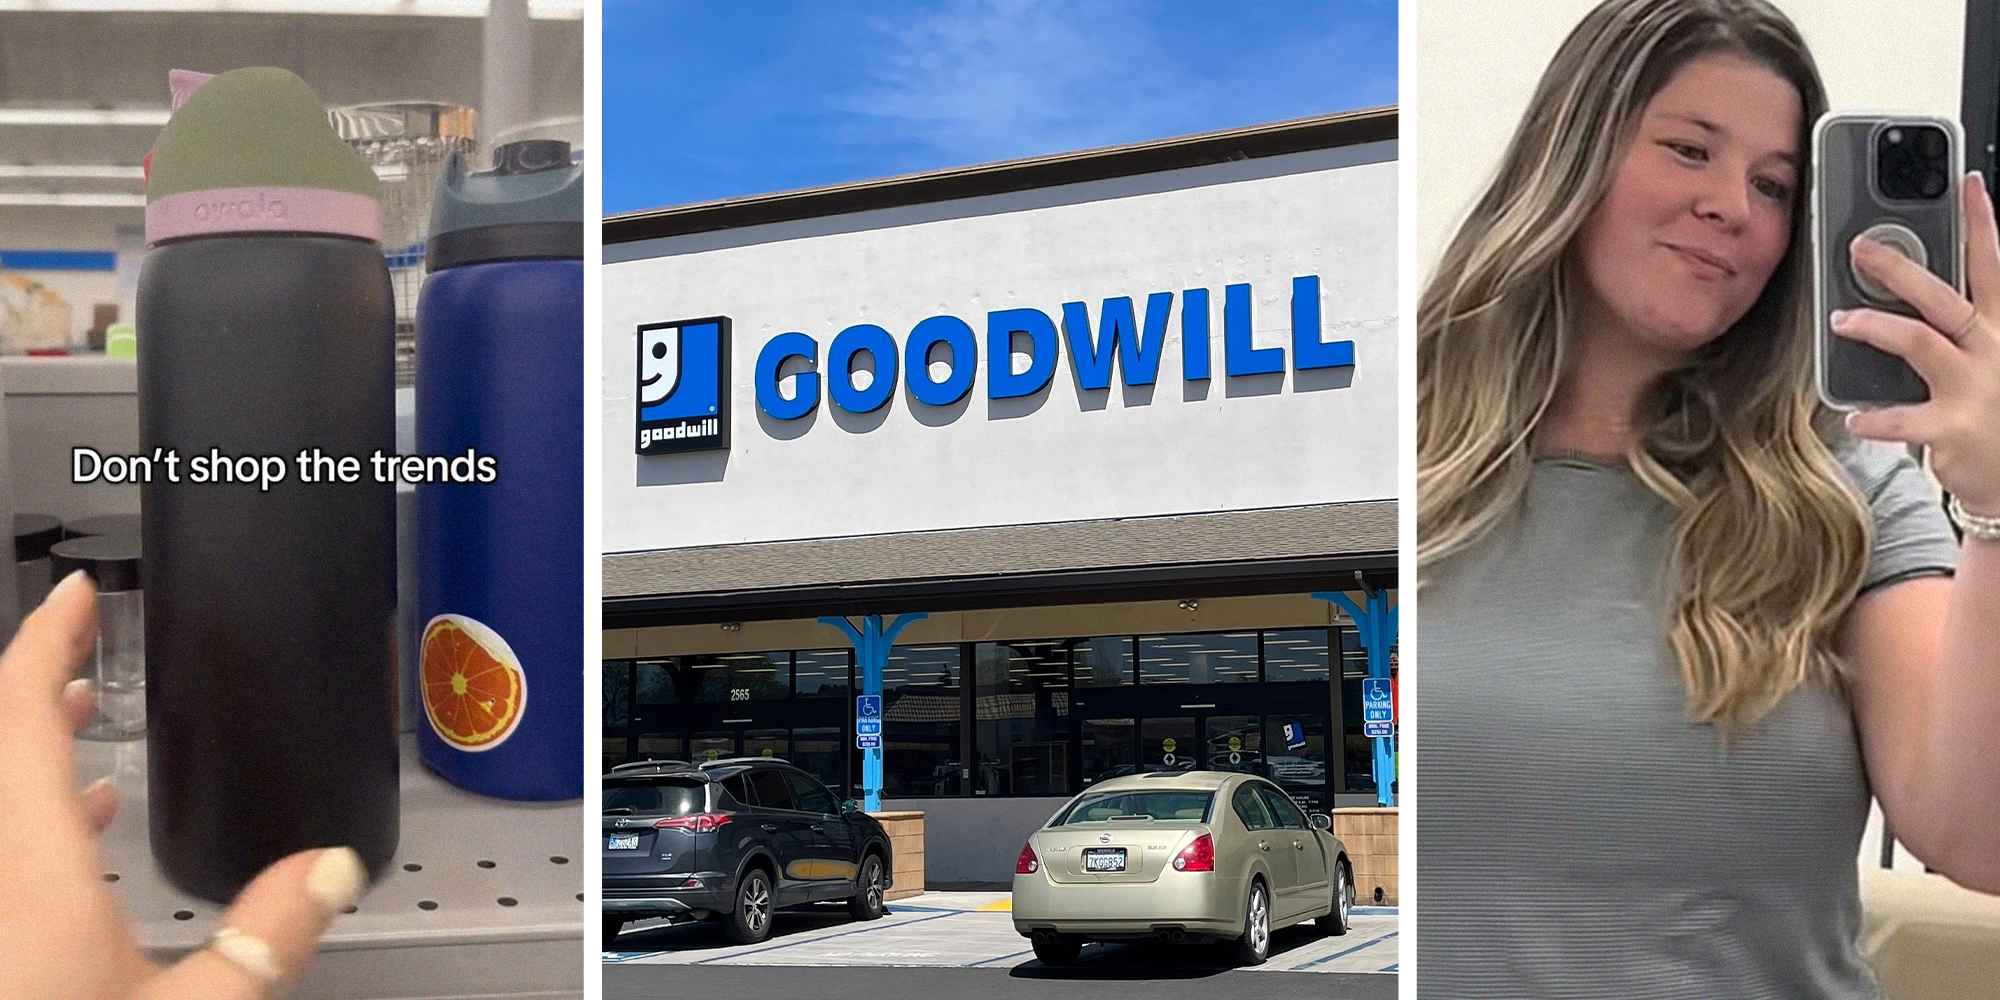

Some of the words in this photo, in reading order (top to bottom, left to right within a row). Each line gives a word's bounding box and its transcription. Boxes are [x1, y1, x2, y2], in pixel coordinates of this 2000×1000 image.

[754, 274, 1355, 420] GOODWILL
[640, 418, 718, 449] goodwill
[730, 688, 750, 701] 2565
[1365, 700, 1391, 710] PARKING
[1370, 710, 1387, 720] ONLY
[861, 724, 877, 733] ONLY
